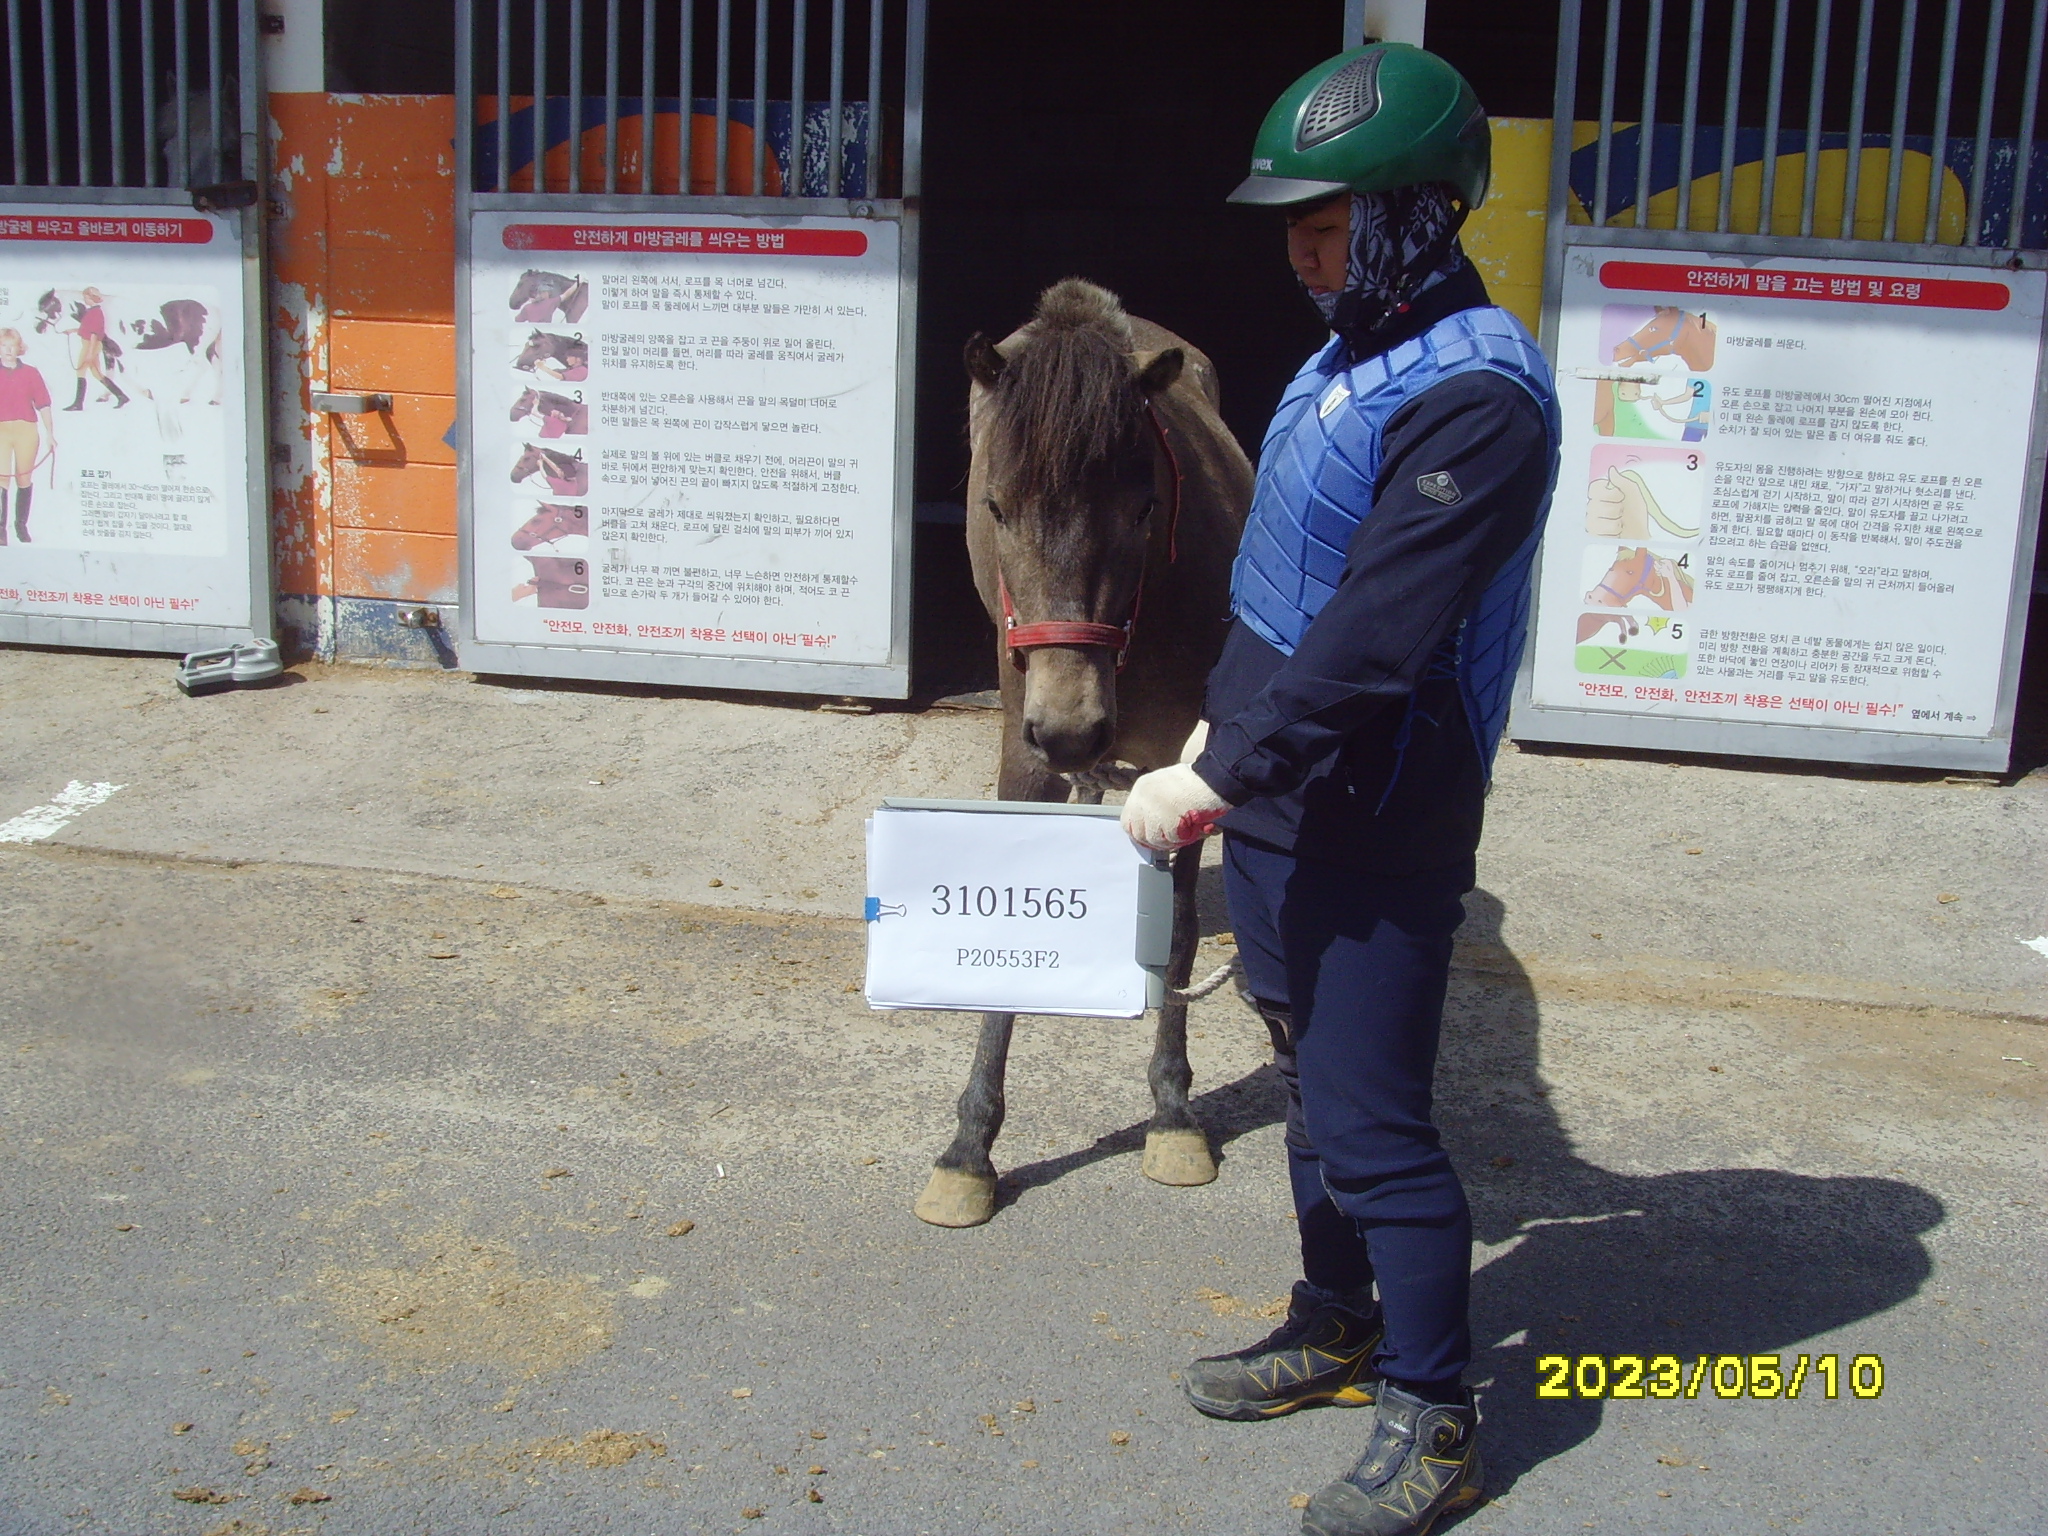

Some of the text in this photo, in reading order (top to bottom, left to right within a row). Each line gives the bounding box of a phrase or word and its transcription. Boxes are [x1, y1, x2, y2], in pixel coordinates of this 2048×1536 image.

[37, 220, 74, 235] 씌우고
[78, 221, 128, 236] 올바르게
[132, 222, 182, 237] 이동하기
[574, 230, 784, 248] 안전하게 마방굴레를 씌우는 방법
[573, 274, 581, 287] 1
[1687, 271, 1921, 300] 안전하게 말을 끄는 방법 및 요령
[1699, 312, 1707, 329] 1
[573, 332, 583, 345] 2
[1727, 336, 1806, 350] 마방굴레를 씌운다.
[573, 390, 583, 404] 3
[1692, 381, 1705, 397] 2
[573, 448, 583, 462] 4
[1686, 454, 1699, 471] 3
[574, 505, 583, 519] 5
[574, 562, 584, 576] 6
[1677, 553, 1689, 569] 4
[27, 590, 68, 603] 안전조끼
[73, 592, 104, 605] 착용은
[108, 594, 139, 607] 선택이
[144, 596, 164, 608] 아닌
[169, 597, 199, 611] 필수!”
[543, 620, 836, 648] “안전모, 안전화, 안전조끼 착용은 선택이 아닌 필수!”
[1671, 624, 1683, 639] 5
[1579, 682, 1903, 717] “안전모, 안전화, 안전조끼 착용은 선택이 아닌 필수!”
[1912, 709, 1963, 722] 옆에서 계속
[931, 885, 1088, 919] 3101565
[956, 948, 1060, 969] P20553F2
